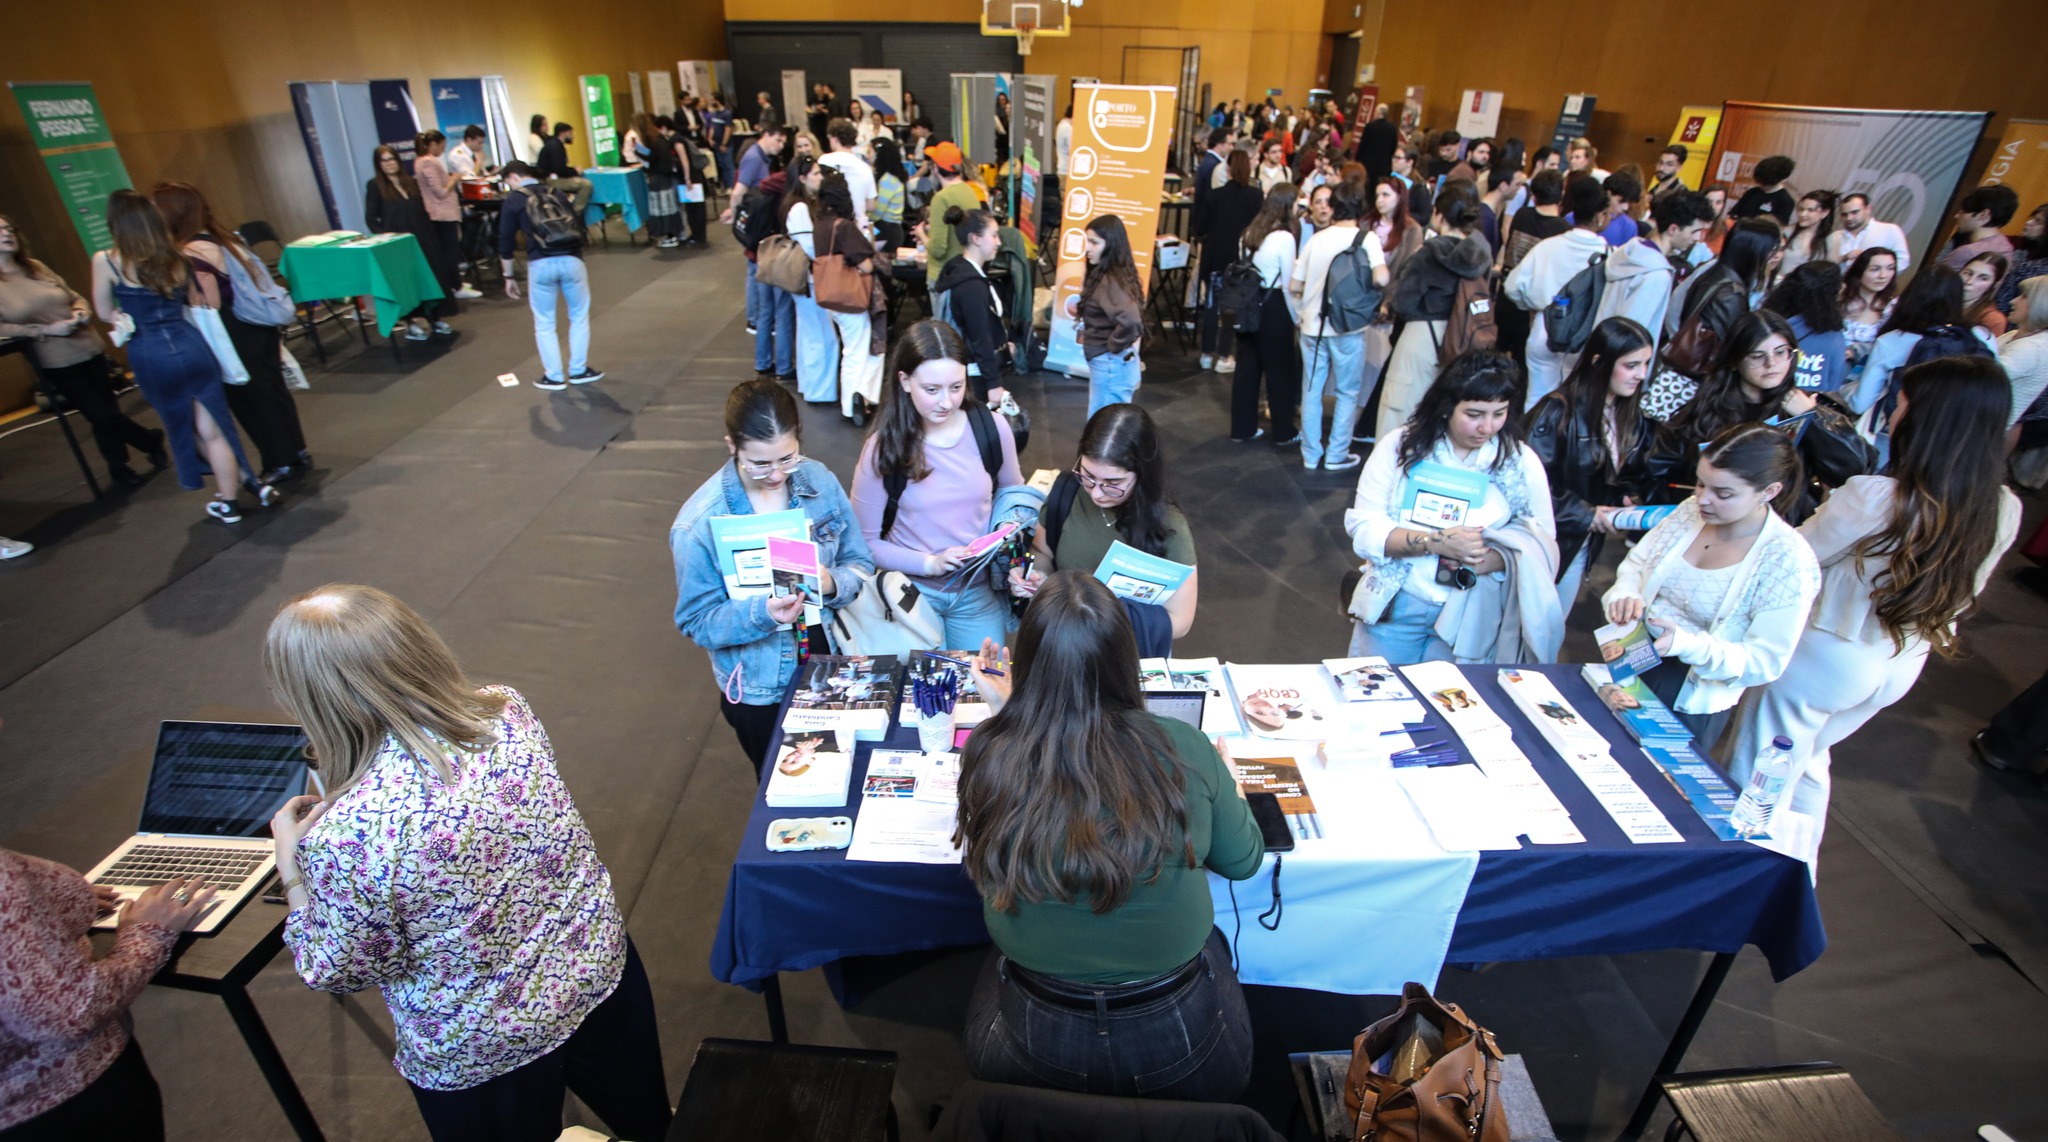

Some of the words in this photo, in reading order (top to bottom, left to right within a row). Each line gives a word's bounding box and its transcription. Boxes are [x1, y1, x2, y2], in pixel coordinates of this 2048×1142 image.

[28, 99, 94, 118] FERNANDO
[1108, 103, 1137, 113] PORTO
[37, 118, 87, 138] PESSOA
